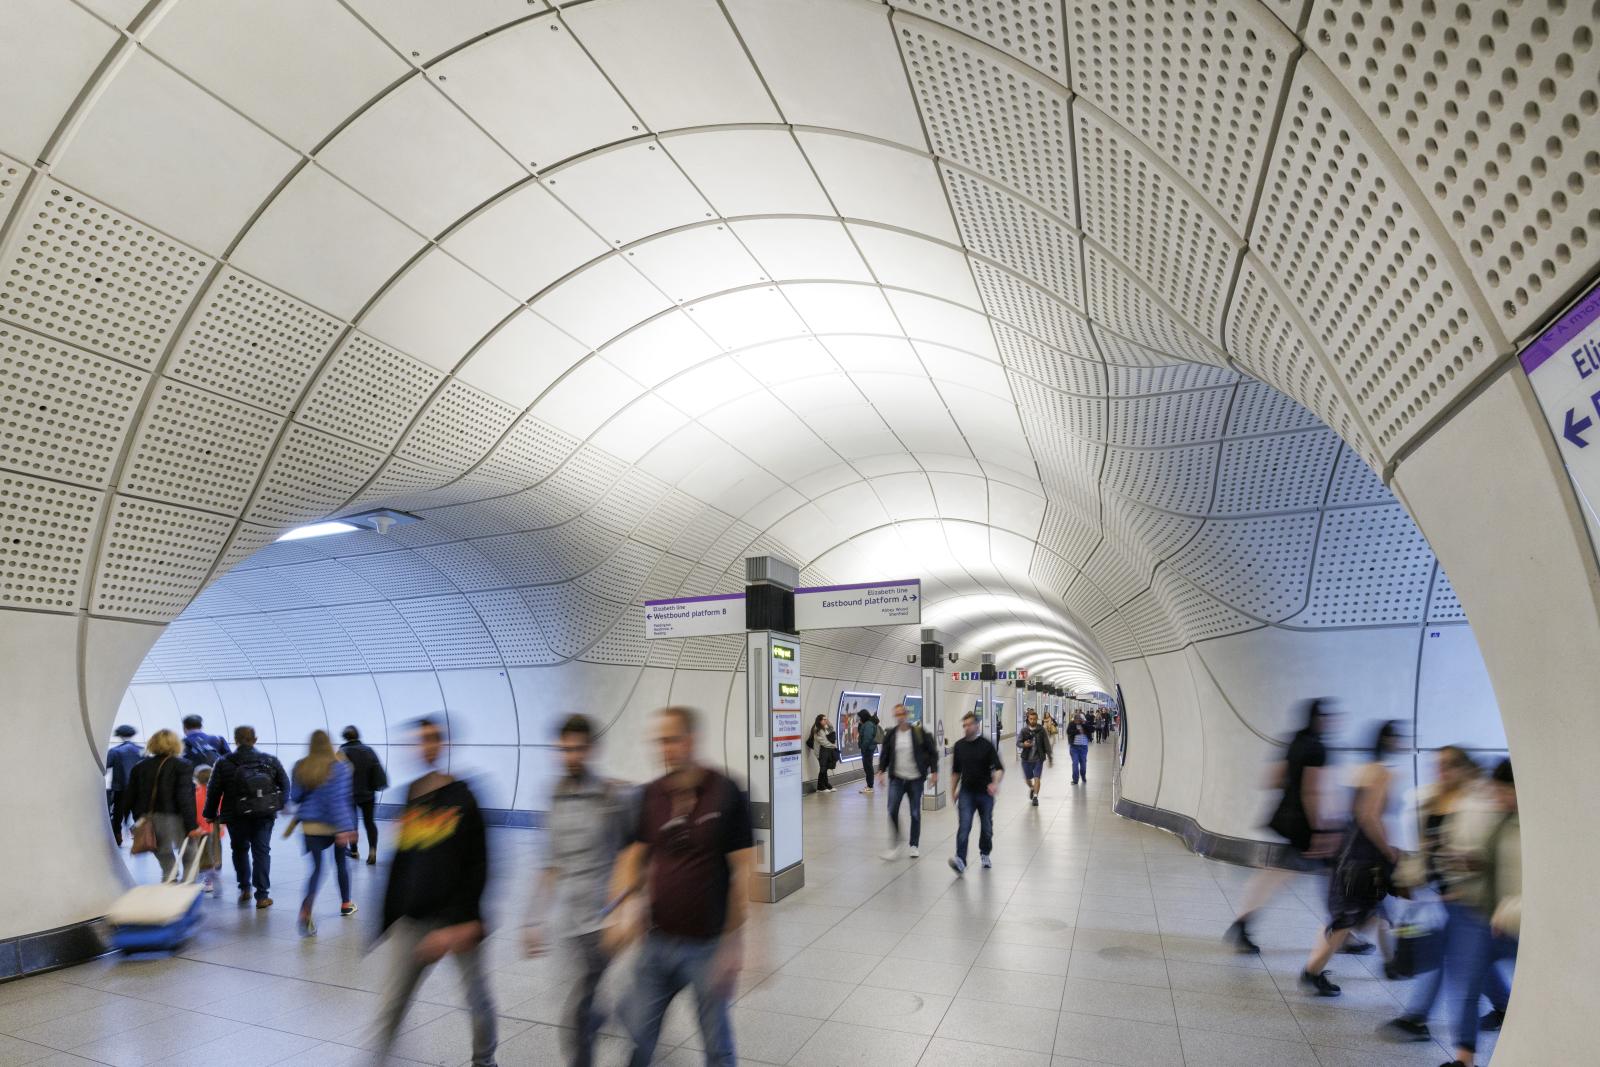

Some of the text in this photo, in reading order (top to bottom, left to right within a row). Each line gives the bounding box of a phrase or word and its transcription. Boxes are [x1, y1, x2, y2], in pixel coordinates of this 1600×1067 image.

[822, 598, 862, 607] Eastbound
[865, 597, 899, 606] platform
[654, 611, 690, 620] Westbound
[692, 610, 720, 618] platform
